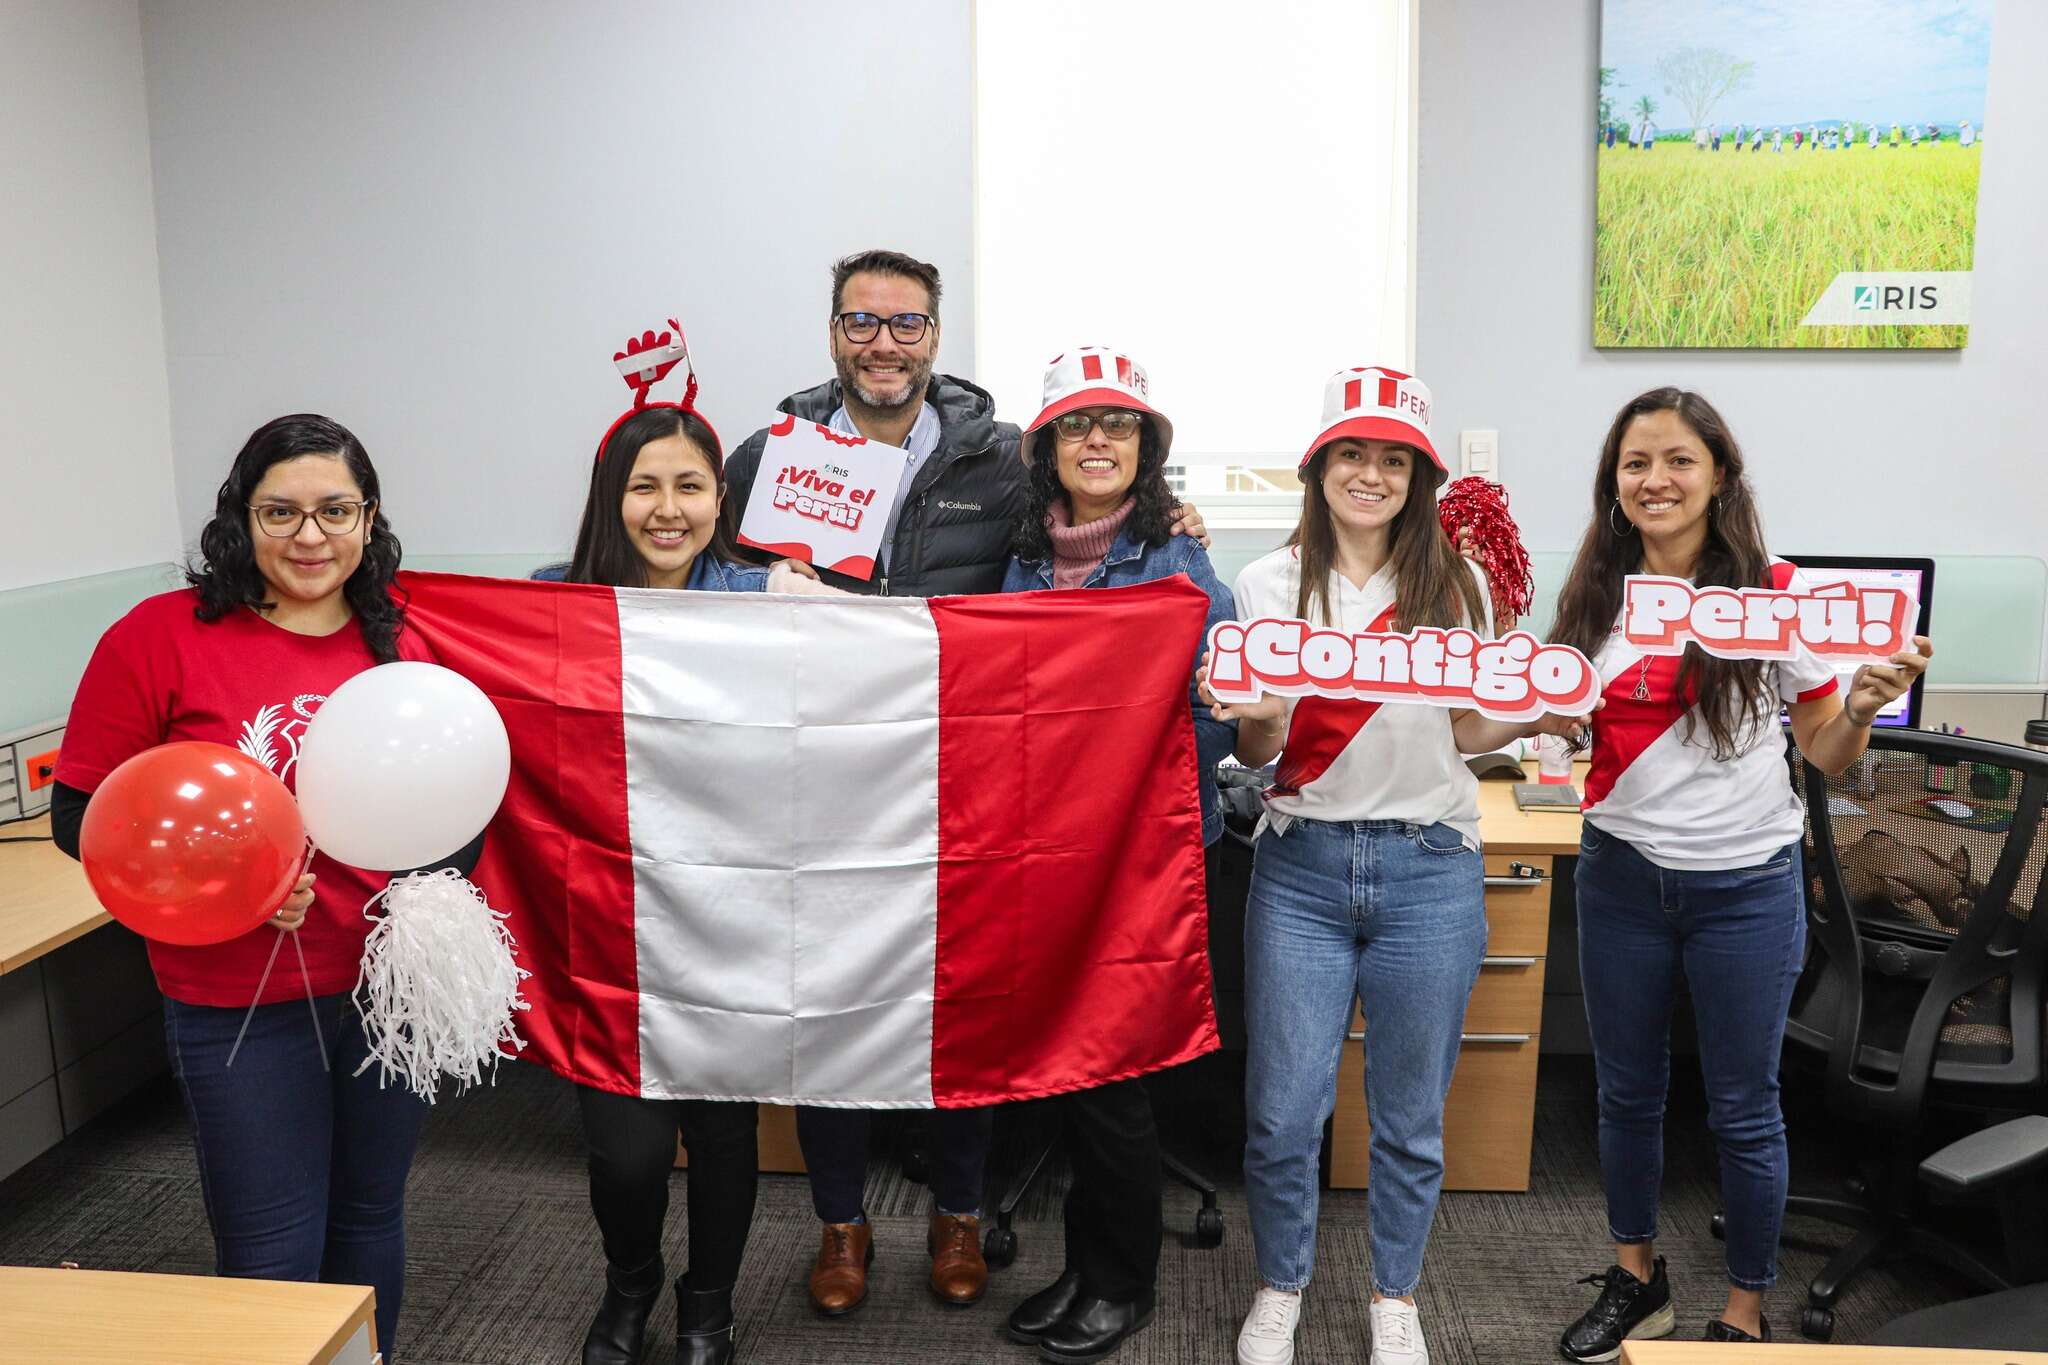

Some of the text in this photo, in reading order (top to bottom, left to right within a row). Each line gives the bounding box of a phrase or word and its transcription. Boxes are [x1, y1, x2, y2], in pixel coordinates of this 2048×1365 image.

[1855, 286, 1938, 310] ARIS
[1134, 371, 1148, 395] PE
[776, 465, 876, 507] ¡Viva el
[946, 500, 982, 511] Columbia
[773, 486, 863, 530] Perú!
[1627, 581, 1902, 651] Perú!
[1211, 619, 1588, 706] ¡Contigo
